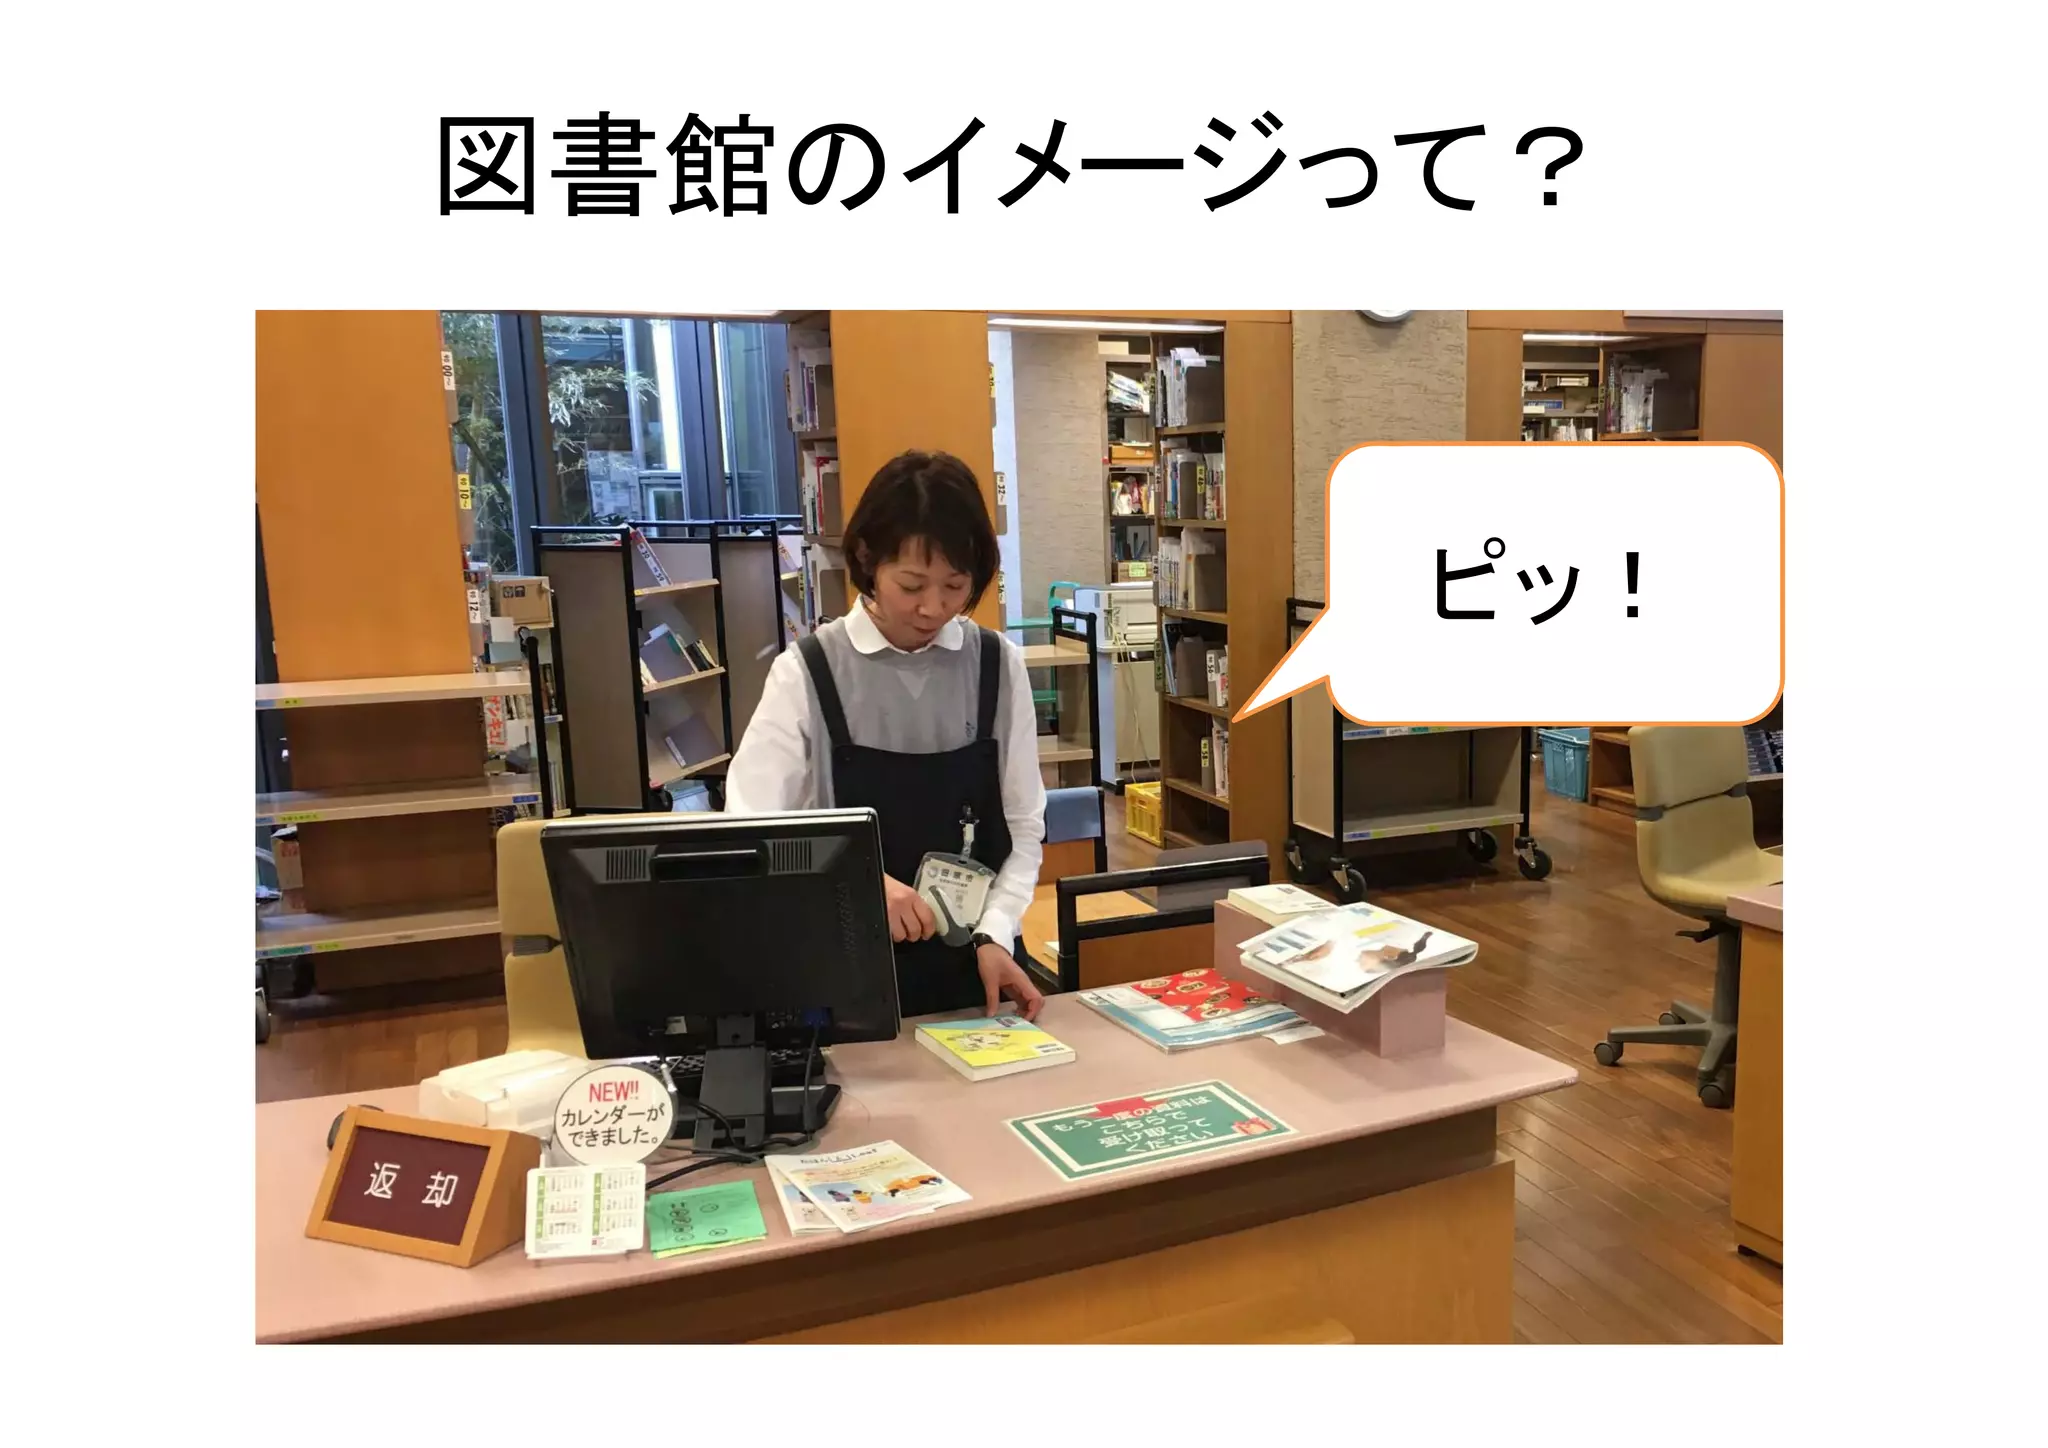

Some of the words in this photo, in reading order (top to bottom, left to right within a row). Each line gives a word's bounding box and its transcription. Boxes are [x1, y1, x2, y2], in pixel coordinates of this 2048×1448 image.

[588, 1080, 639, 1103] NEW!!
[561, 1102, 665, 1127] カレンダーが
[1100, 1110, 1188, 1134] こちらで
[568, 1125, 659, 1147] できました。
[1098, 1117, 1212, 1148] 受け取って
[1125, 1130, 1215, 1153] ください
